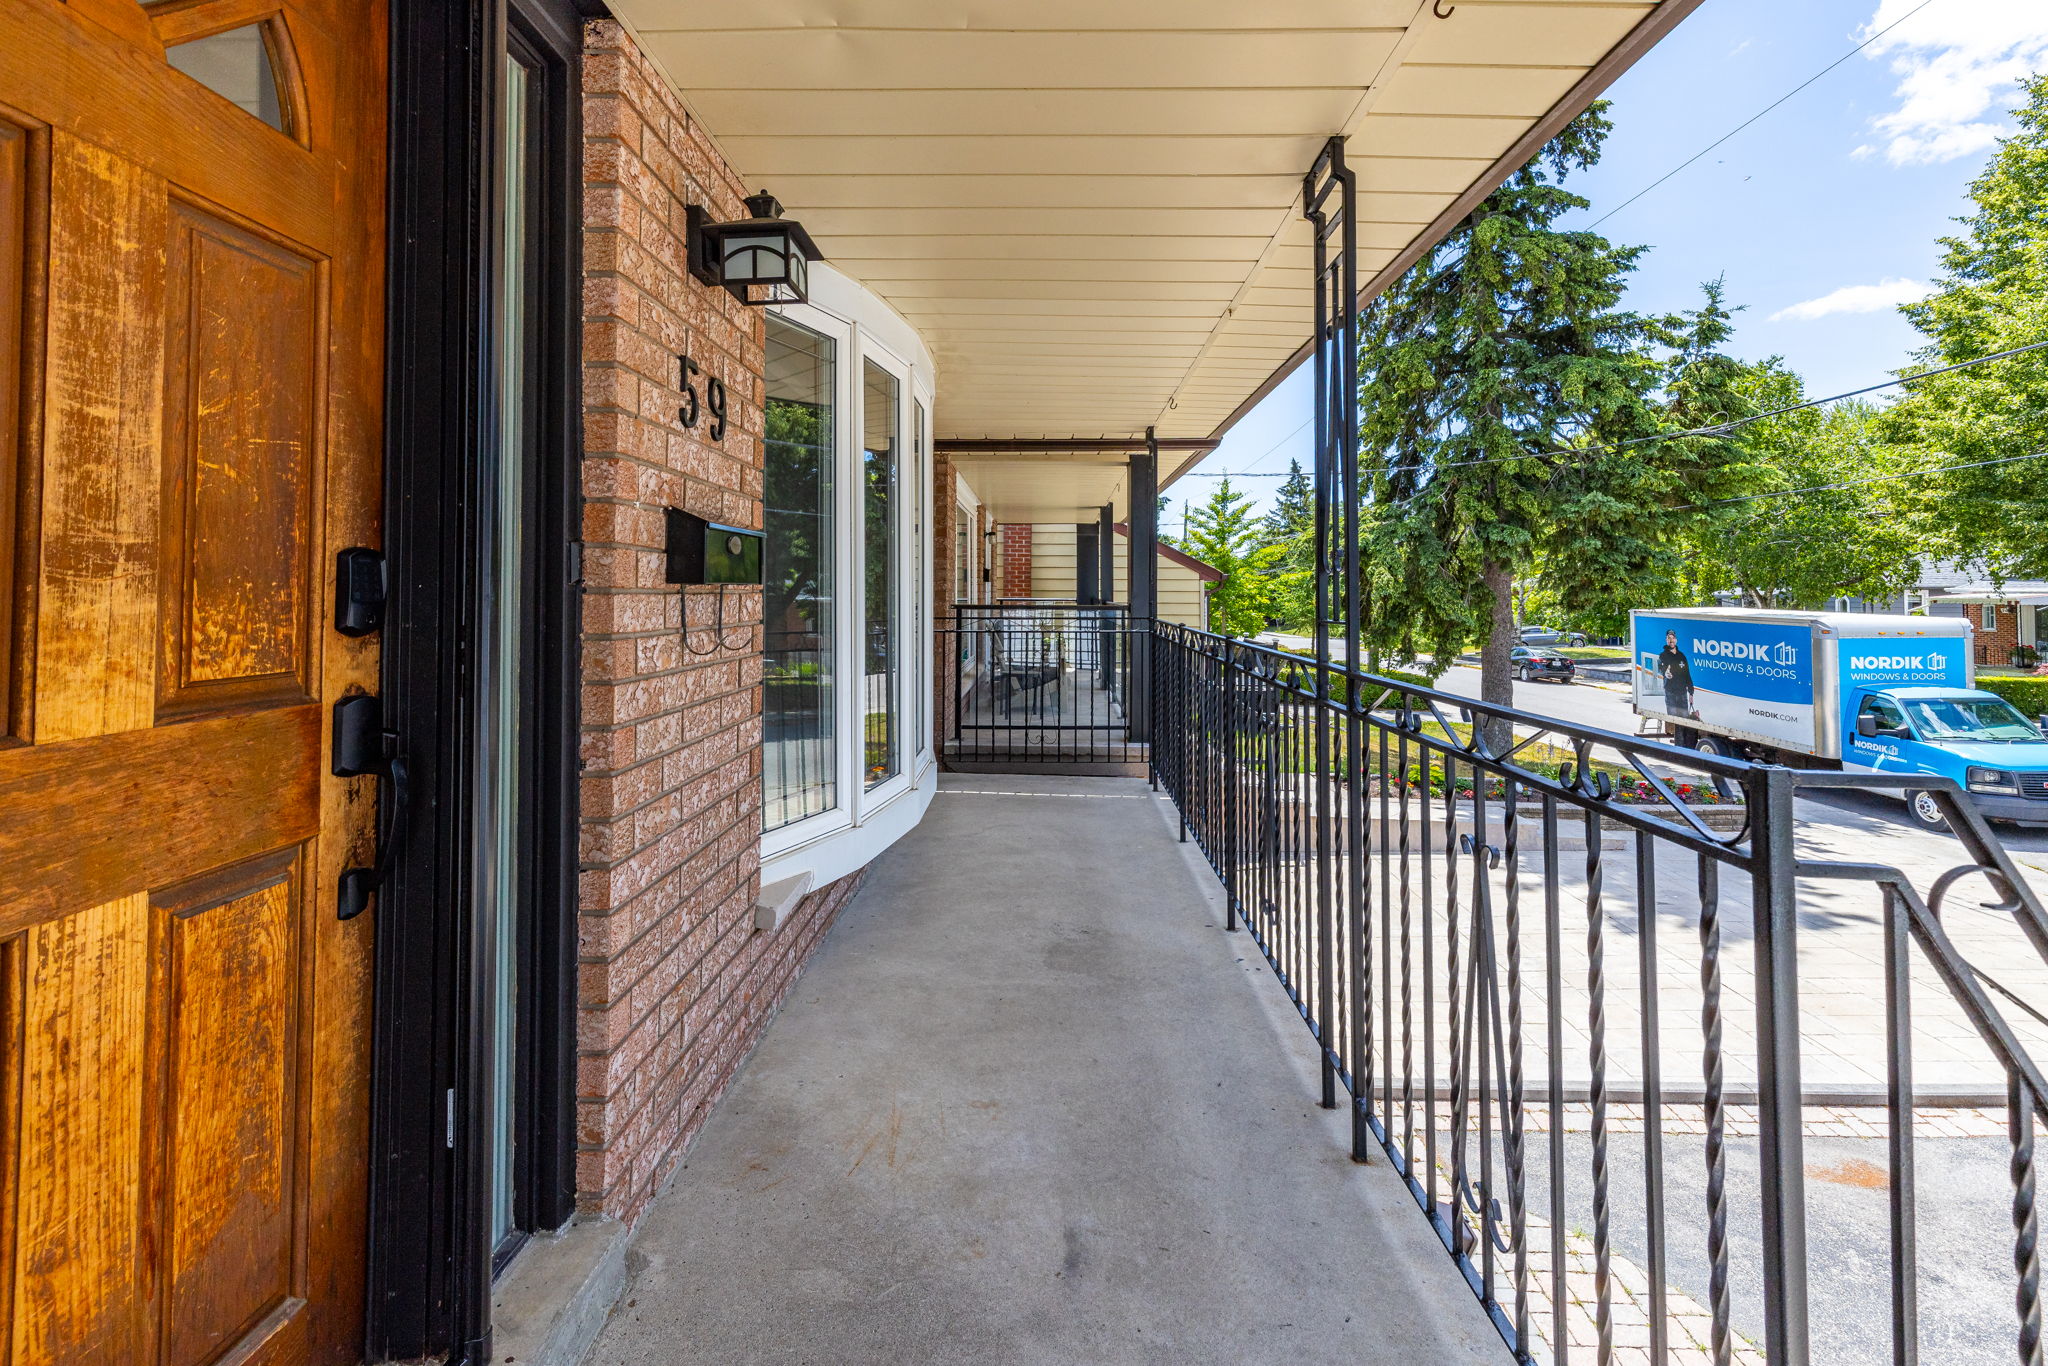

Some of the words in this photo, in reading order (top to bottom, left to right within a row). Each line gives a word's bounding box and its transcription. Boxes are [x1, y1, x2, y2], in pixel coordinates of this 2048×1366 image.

[679, 355, 726, 442] 59
[1693, 638, 1770, 662] NORDIK
[1693, 658, 1744, 673] WINDOWS
[1746, 664, 1754, 674] &
[1756, 665, 1797, 680] DOORS
[1850, 656, 1924, 669] NORDIK
[1850, 672, 1901, 680] WINDOWS
[1902, 672, 1909, 680] &
[1911, 672, 1946, 680] DOORS
[1748, 708, 1798, 723] NORDIK.COM
[1854, 740, 1889, 754] NORDIK
